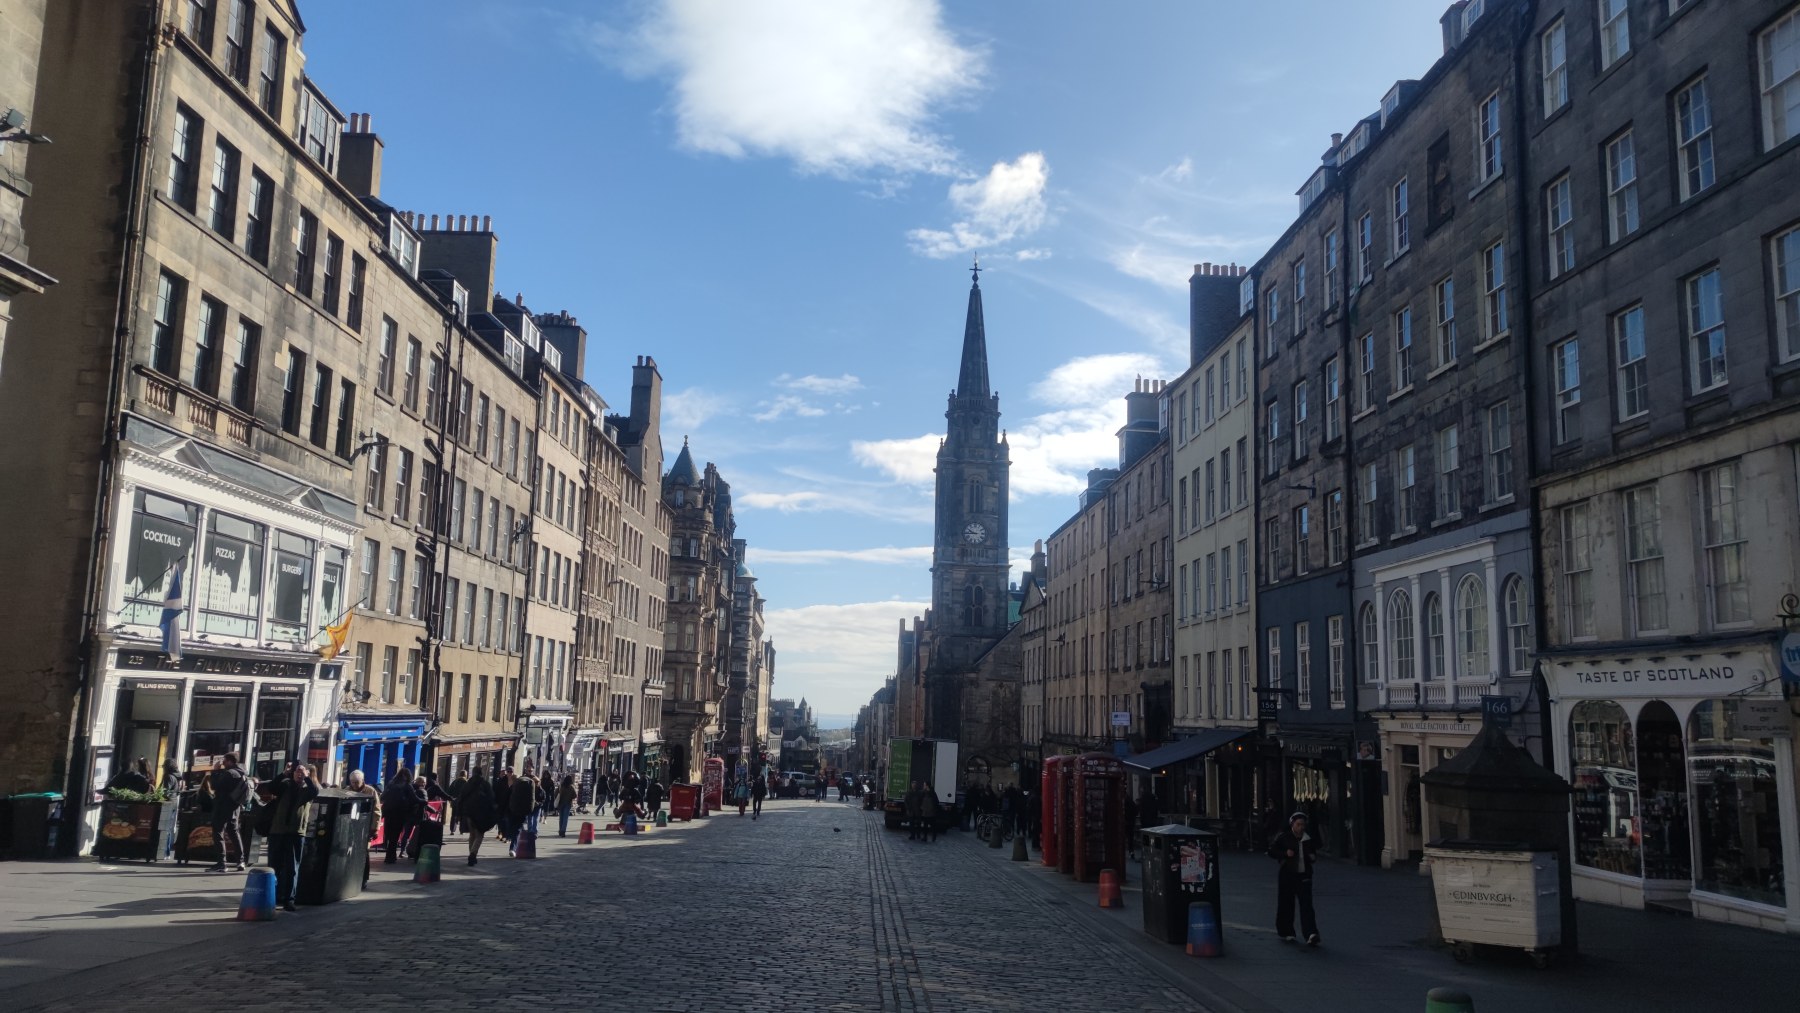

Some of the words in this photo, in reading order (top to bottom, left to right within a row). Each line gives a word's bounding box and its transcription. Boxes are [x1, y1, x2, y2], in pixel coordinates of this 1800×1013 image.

[143, 529, 181, 548] COCKTAILS
[215, 546, 236, 560] PIZZAS
[281, 563, 302, 576] BURGERS
[128, 655, 144, 665] 235
[193, 658, 242, 673] FILLING
[251, 662, 293, 676] STATION
[1577, 671, 1618, 684] TASTE
[1623, 670, 1641, 682] OF
[1647, 666, 1735, 682] SCOTLAND
[136, 682, 157, 690] FILLING
[1261, 701, 1275, 709] 156
[1486, 701, 1508, 714] 166
[1449, 723, 1471, 731] OUTLET
